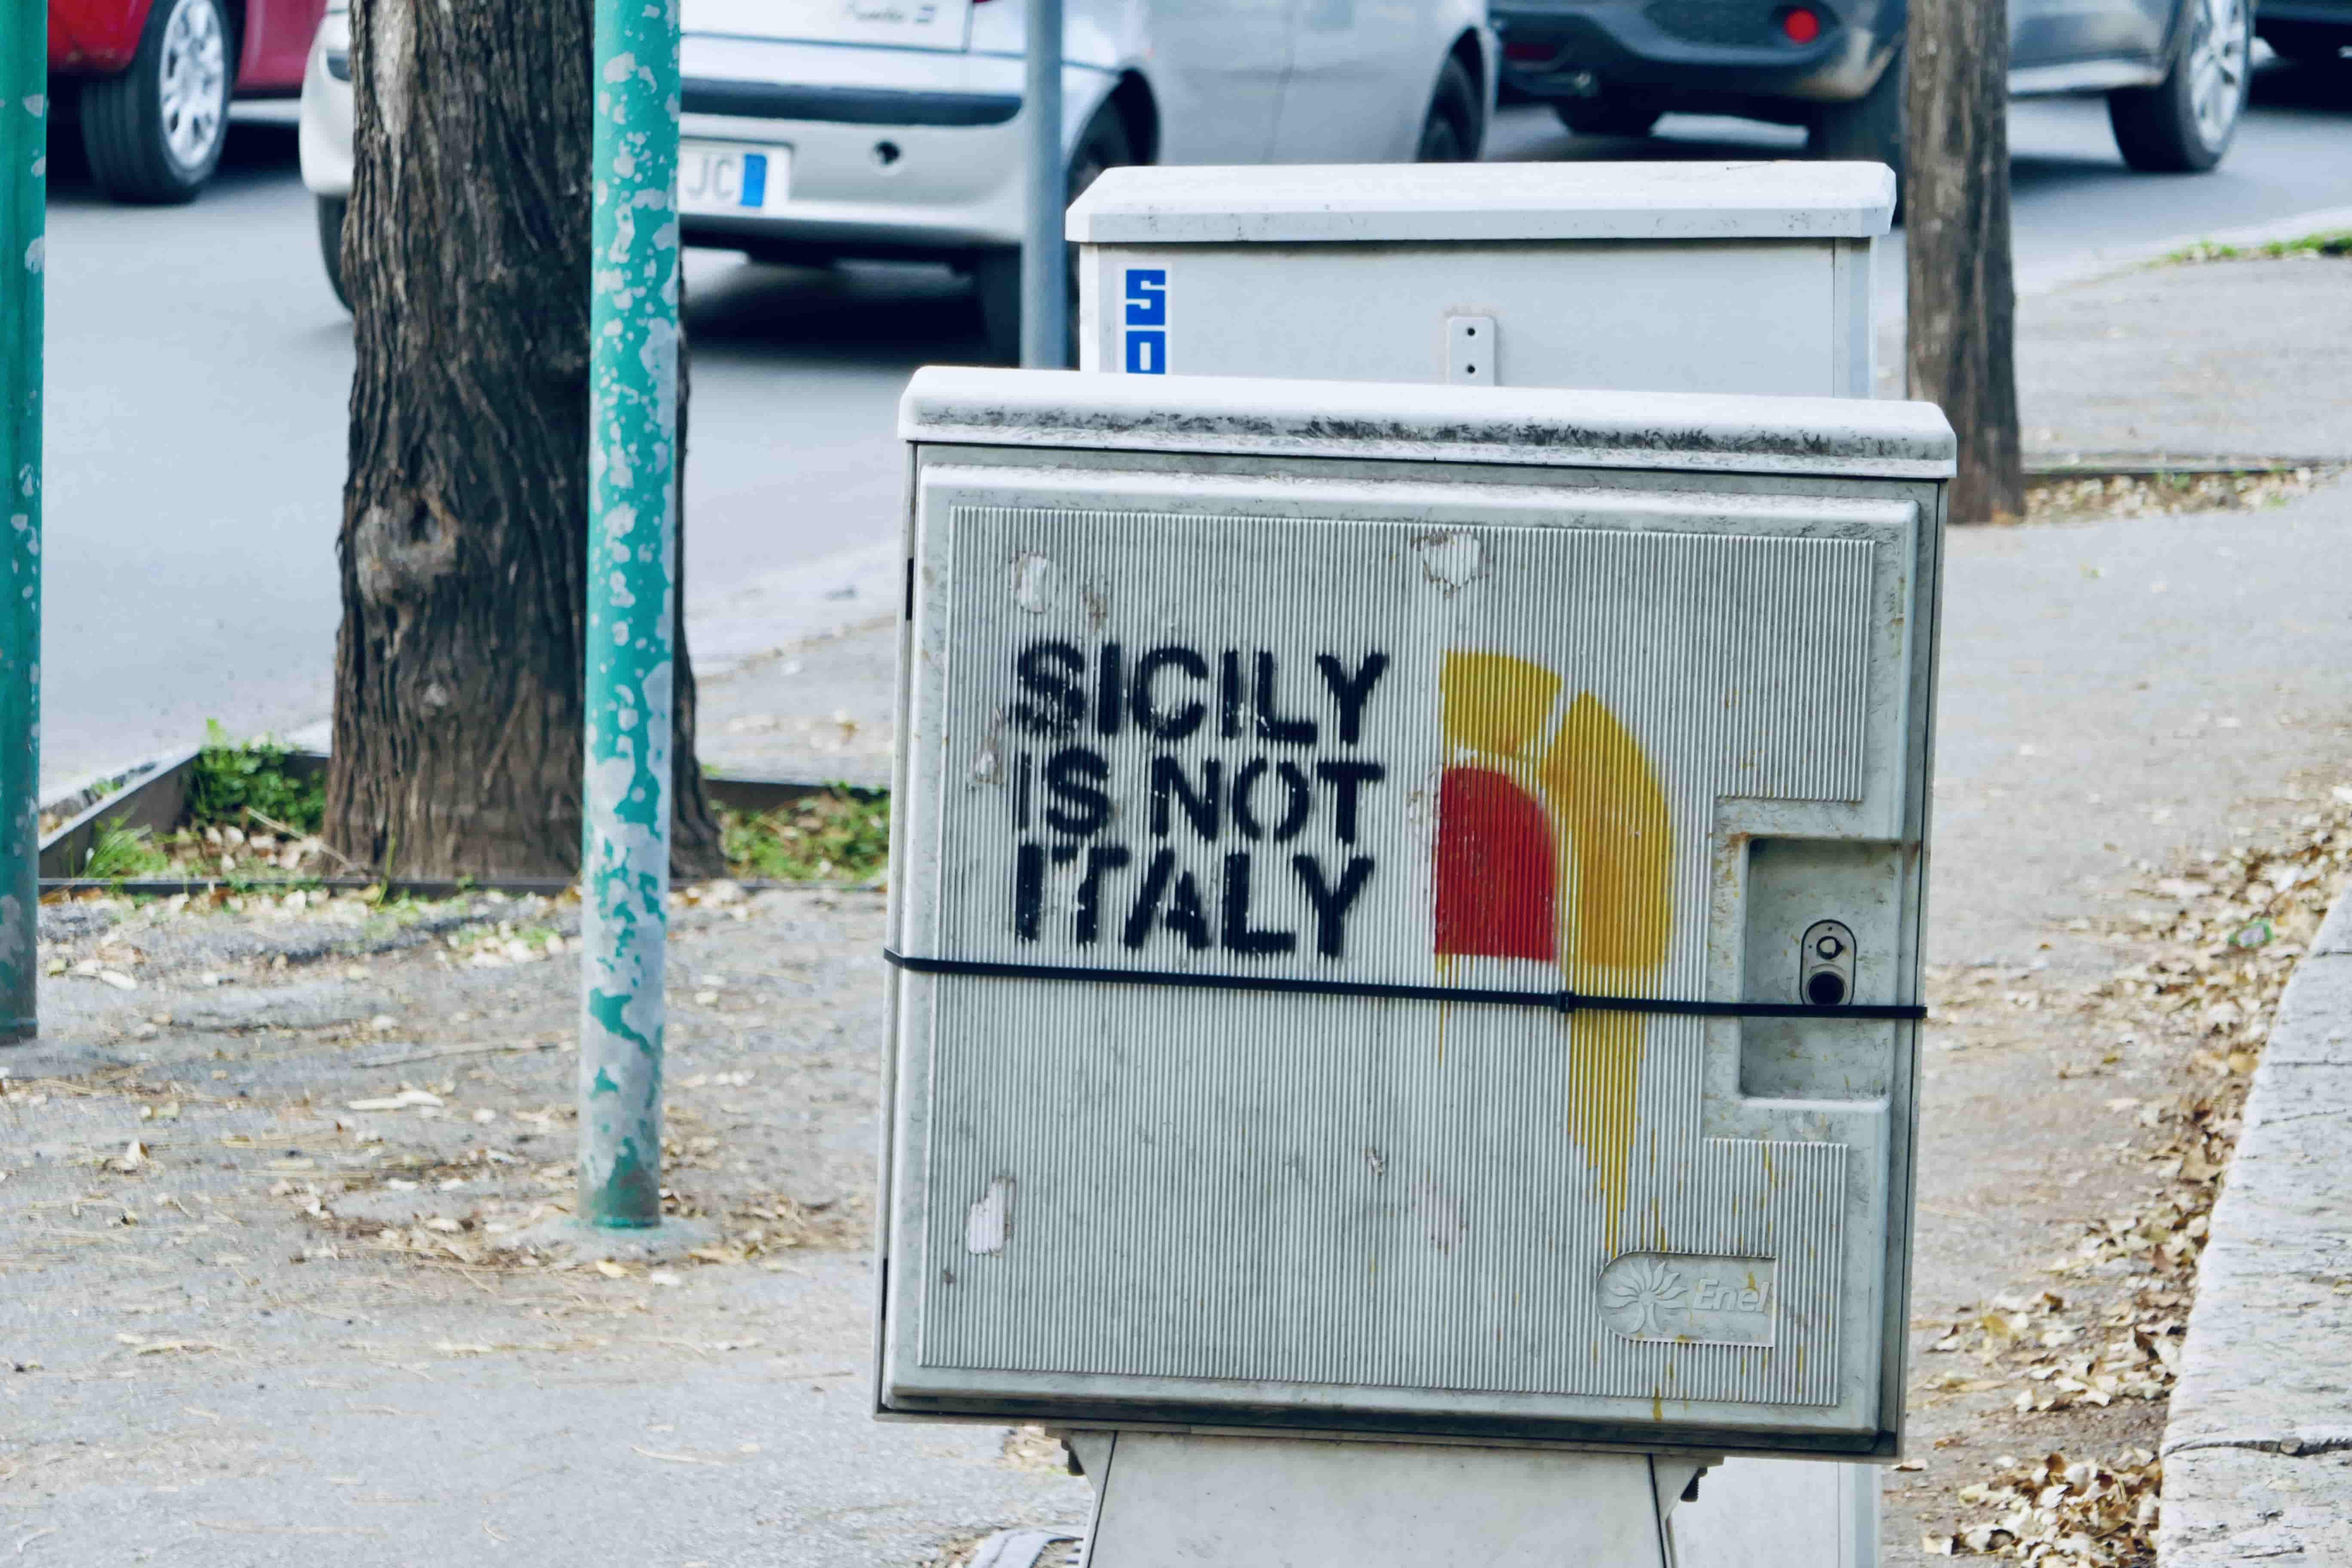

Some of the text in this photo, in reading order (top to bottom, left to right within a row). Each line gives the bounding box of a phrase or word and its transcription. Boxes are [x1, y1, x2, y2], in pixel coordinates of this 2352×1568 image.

[1011, 640, 1390, 746] SICILY
[1016, 747, 1385, 843] IS NOT
[1015, 842, 1375, 959] ITALY
[1693, 1278, 1772, 1313] Enel
